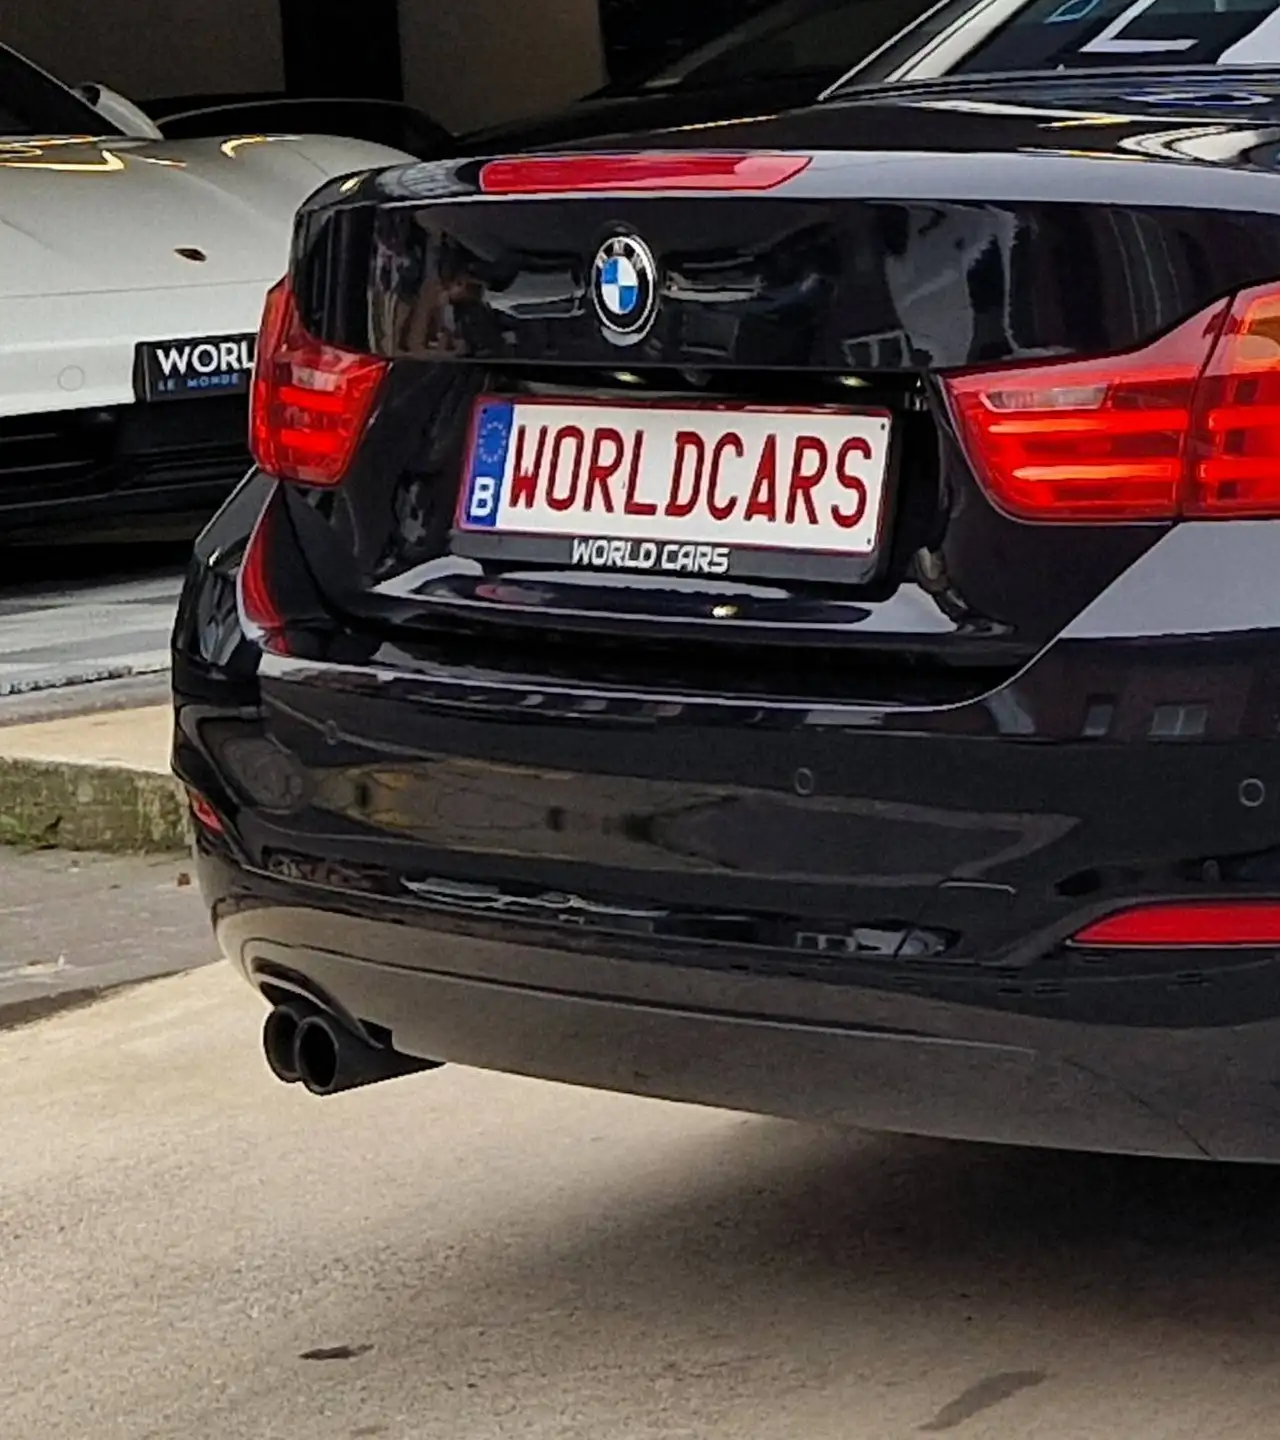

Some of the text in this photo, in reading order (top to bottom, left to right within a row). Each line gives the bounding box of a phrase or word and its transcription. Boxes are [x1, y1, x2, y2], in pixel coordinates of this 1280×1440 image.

[469, 424, 873, 530] B WORLDCARS
[571, 538, 731, 575] WORLD CARS
